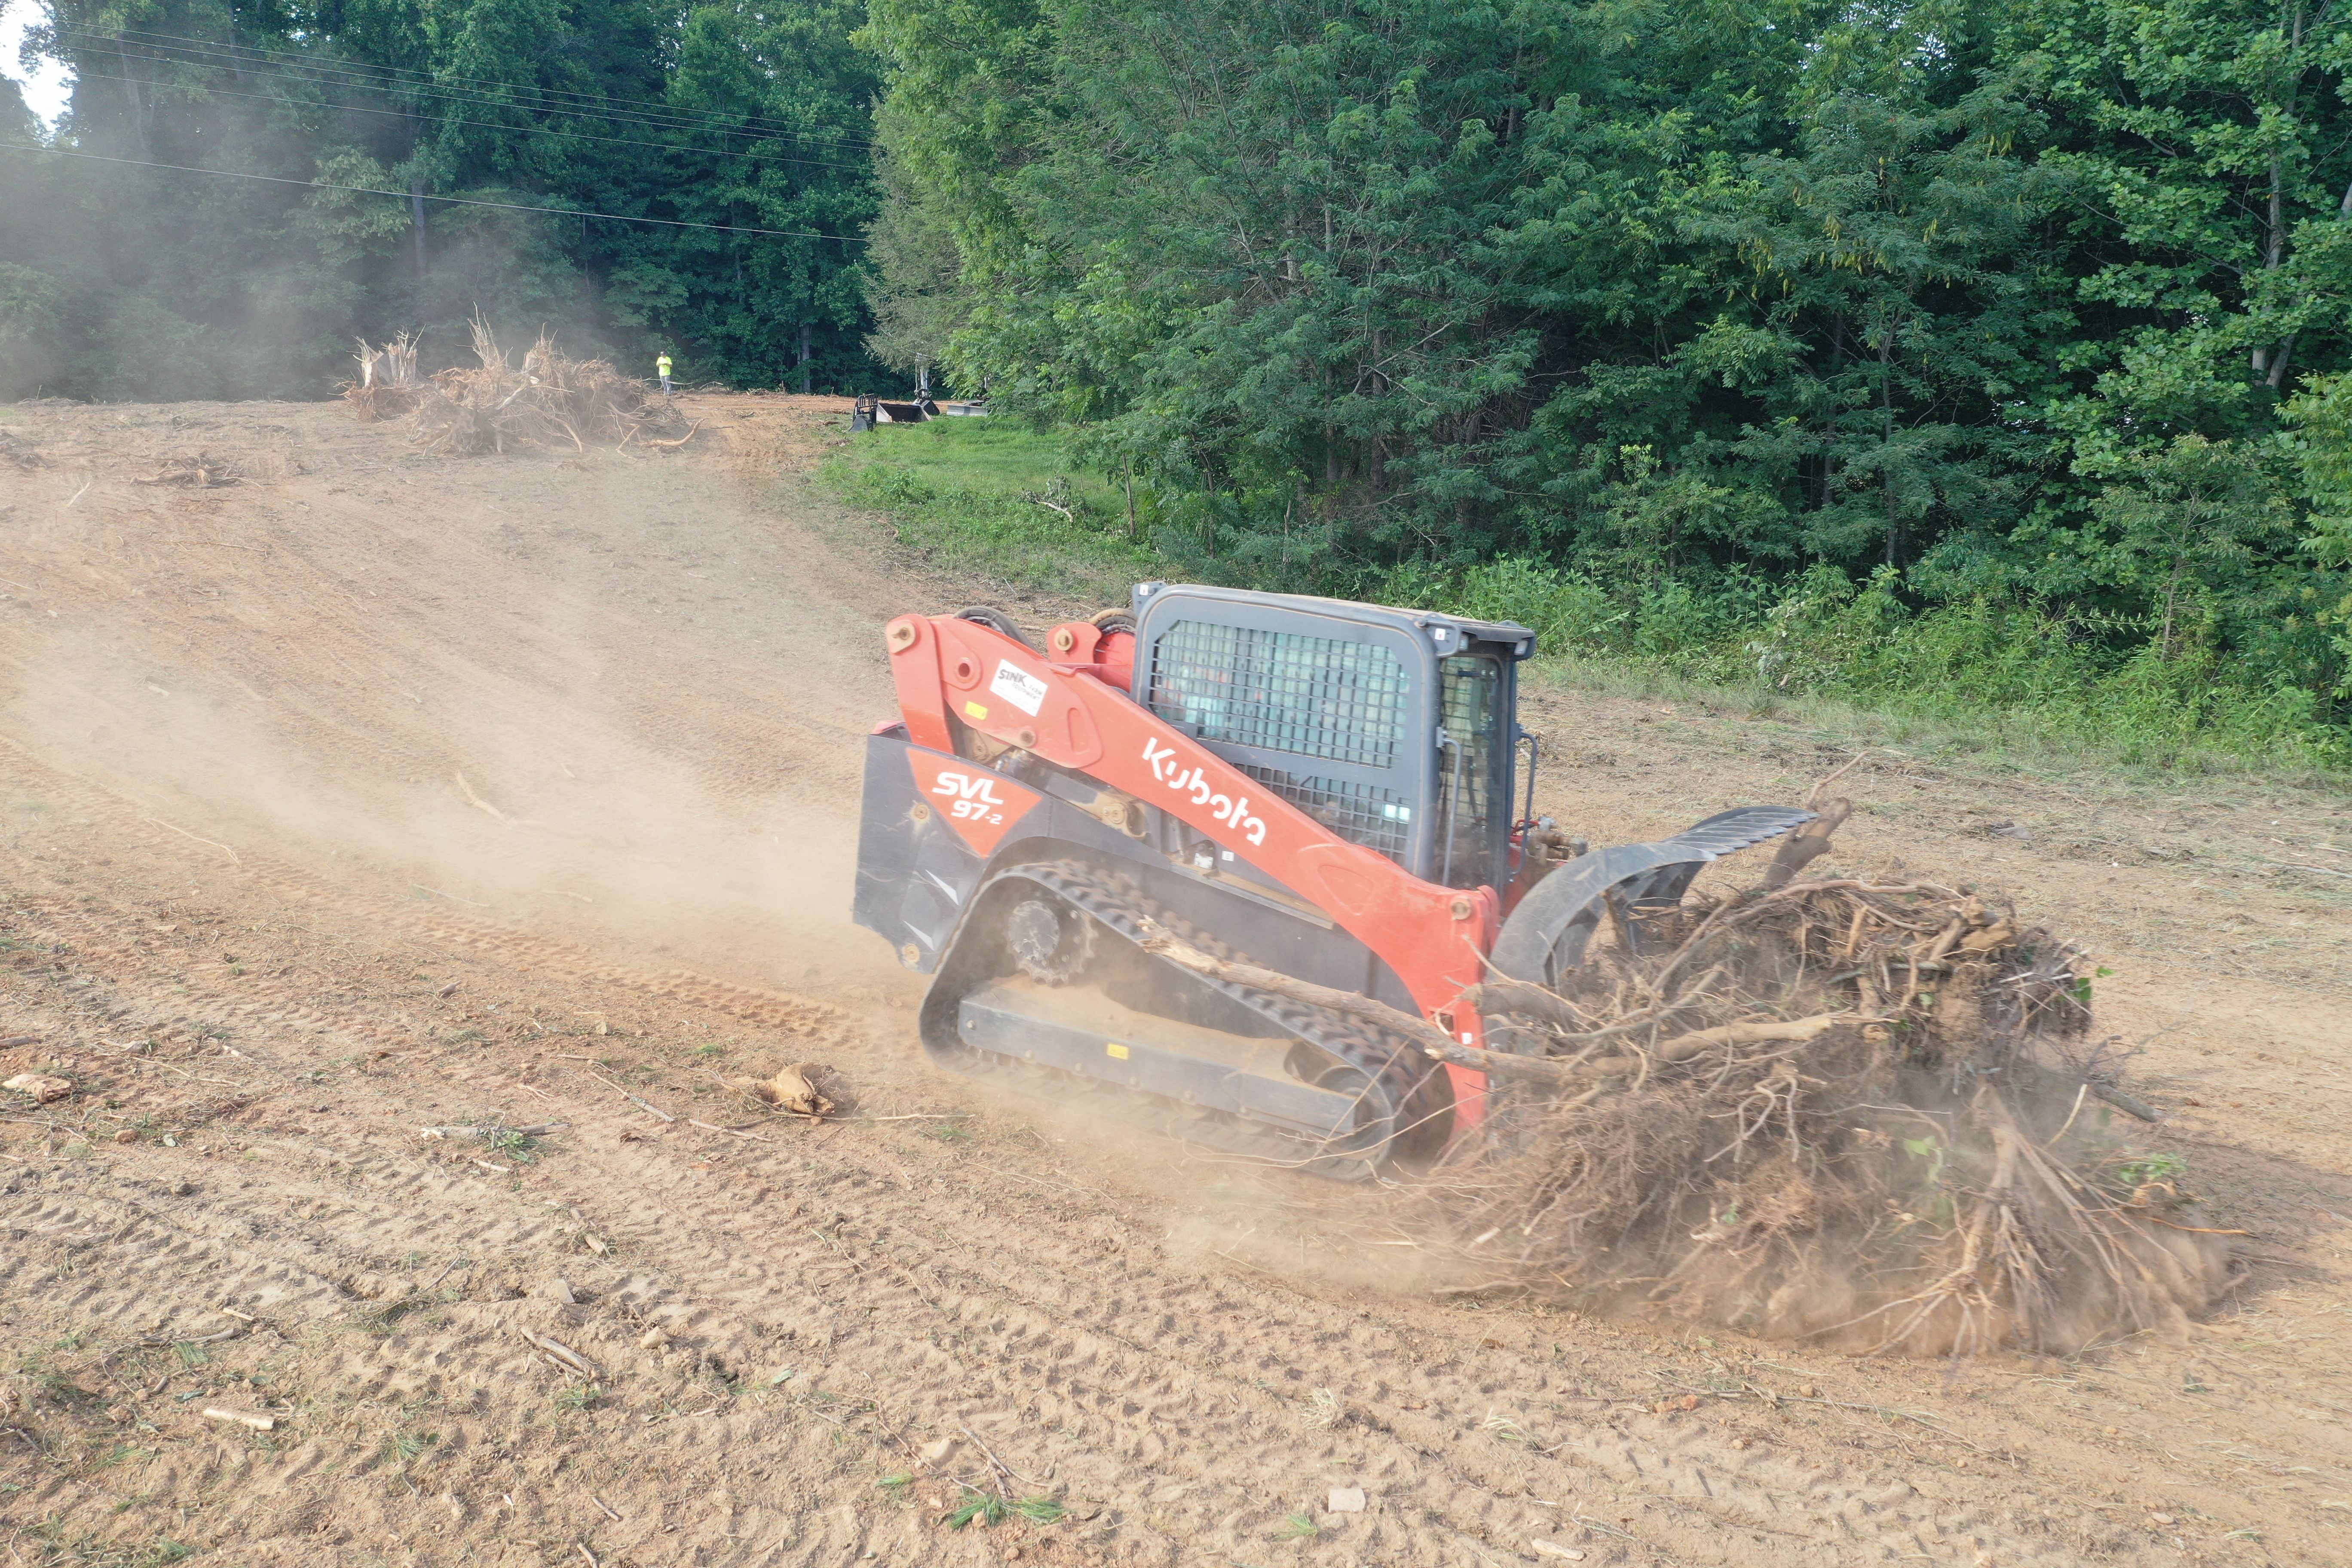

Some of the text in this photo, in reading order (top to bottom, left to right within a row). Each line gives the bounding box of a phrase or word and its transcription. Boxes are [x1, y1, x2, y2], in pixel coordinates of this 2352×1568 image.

[998, 669, 1027, 687] SINK
[932, 772, 1004, 805] SVL
[1142, 737, 1266, 846] Kubota
[950, 800, 1003, 825] 97-2
